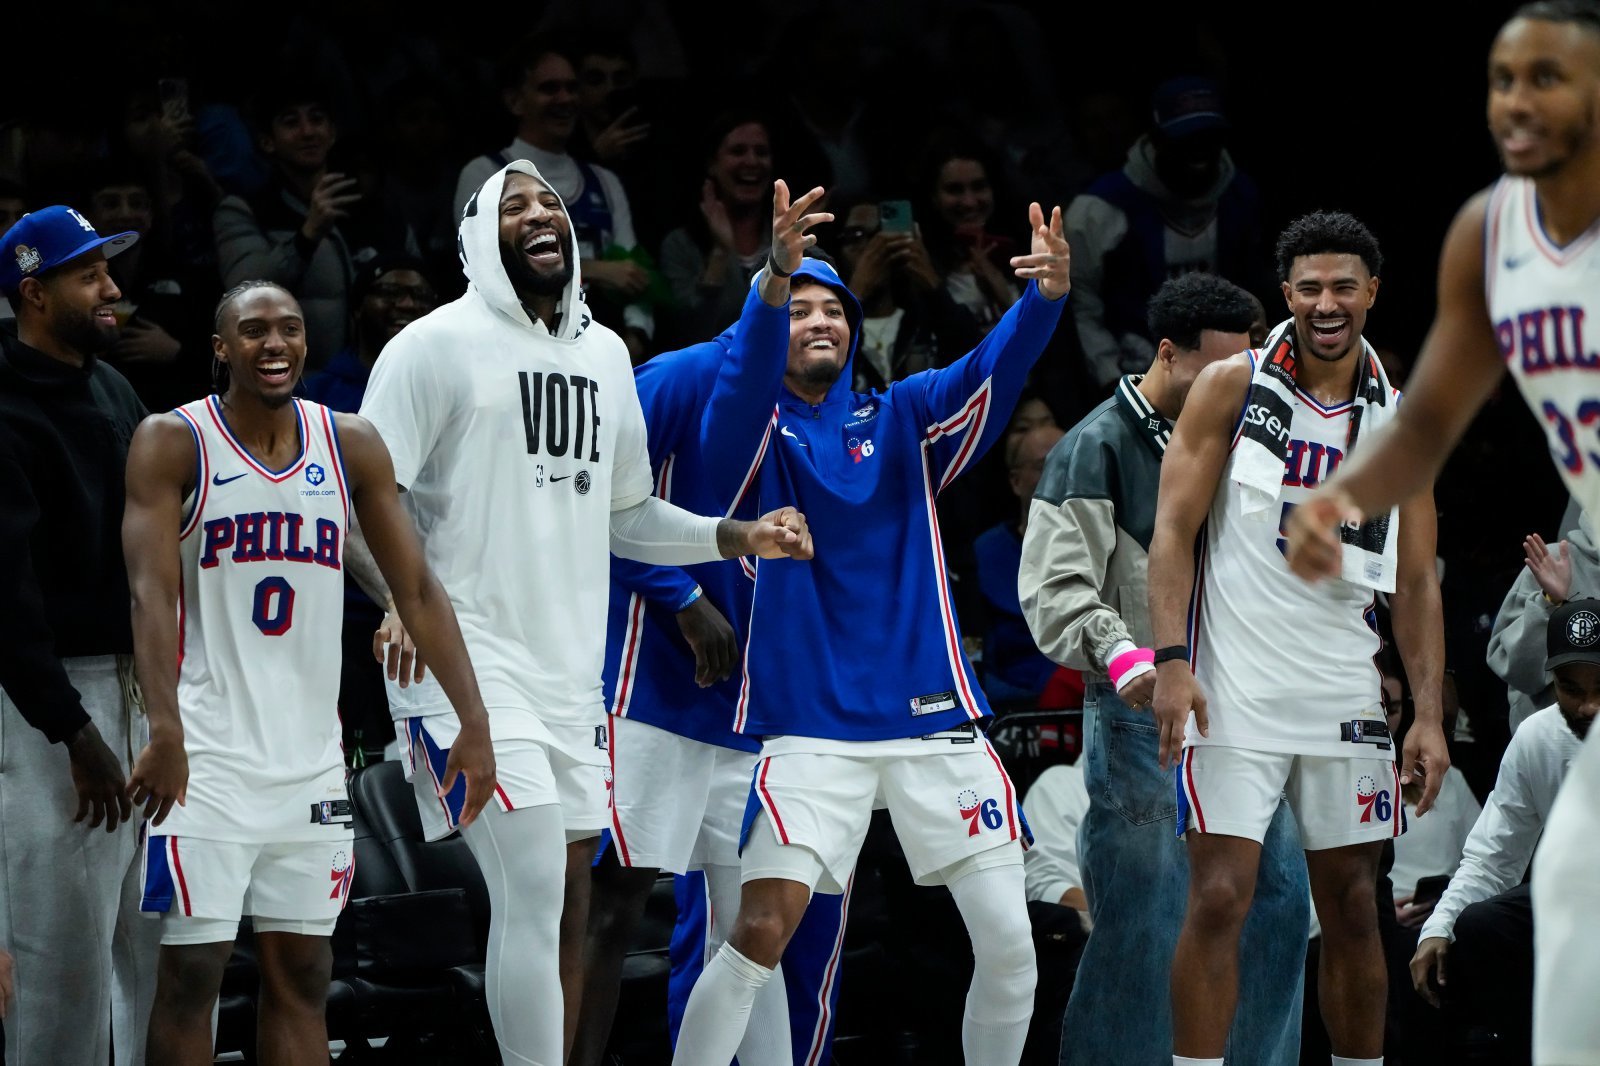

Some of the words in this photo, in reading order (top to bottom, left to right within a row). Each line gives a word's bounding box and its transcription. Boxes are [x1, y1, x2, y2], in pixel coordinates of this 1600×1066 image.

[518, 371, 600, 463] VOTE
[849, 439, 874, 464] 76
[300, 489, 336, 497] crypto.com
[200, 511, 341, 571] PHILA
[252, 576, 295, 636] 0
[1569, 613, 1598, 626] BROOKLYN
[1570, 634, 1580, 644] NEW
[1583, 634, 1597, 644] YORK
[959, 798, 1003, 838] 76
[1357, 789, 1392, 823] 76
